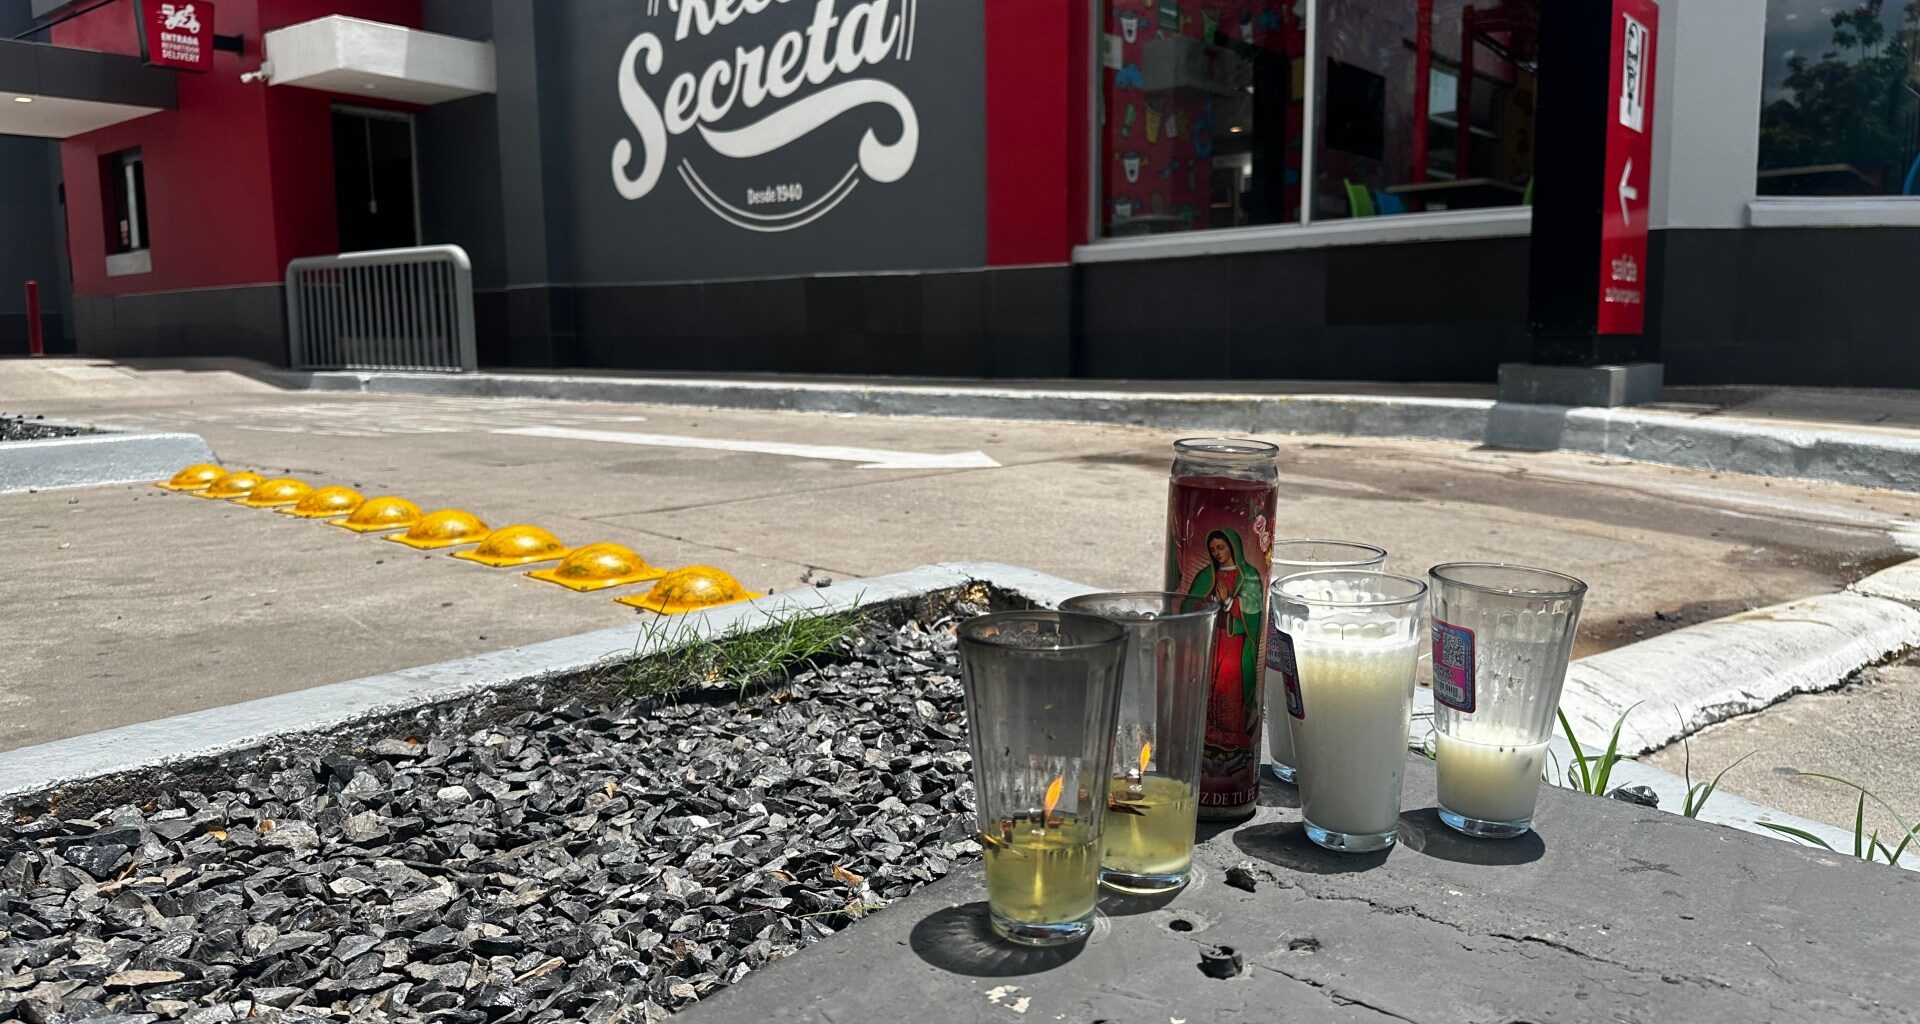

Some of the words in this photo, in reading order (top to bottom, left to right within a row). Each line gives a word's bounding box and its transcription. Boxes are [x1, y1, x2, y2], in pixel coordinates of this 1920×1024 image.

[161, 32, 199, 46] ENTRADA
[162, 49, 199, 63] DELIVERY
[611, 0, 899, 200] Secreta
[747, 186, 776, 205] Desde
[1213, 793, 1229, 805] DE
[1232, 791, 1246, 804] TU
